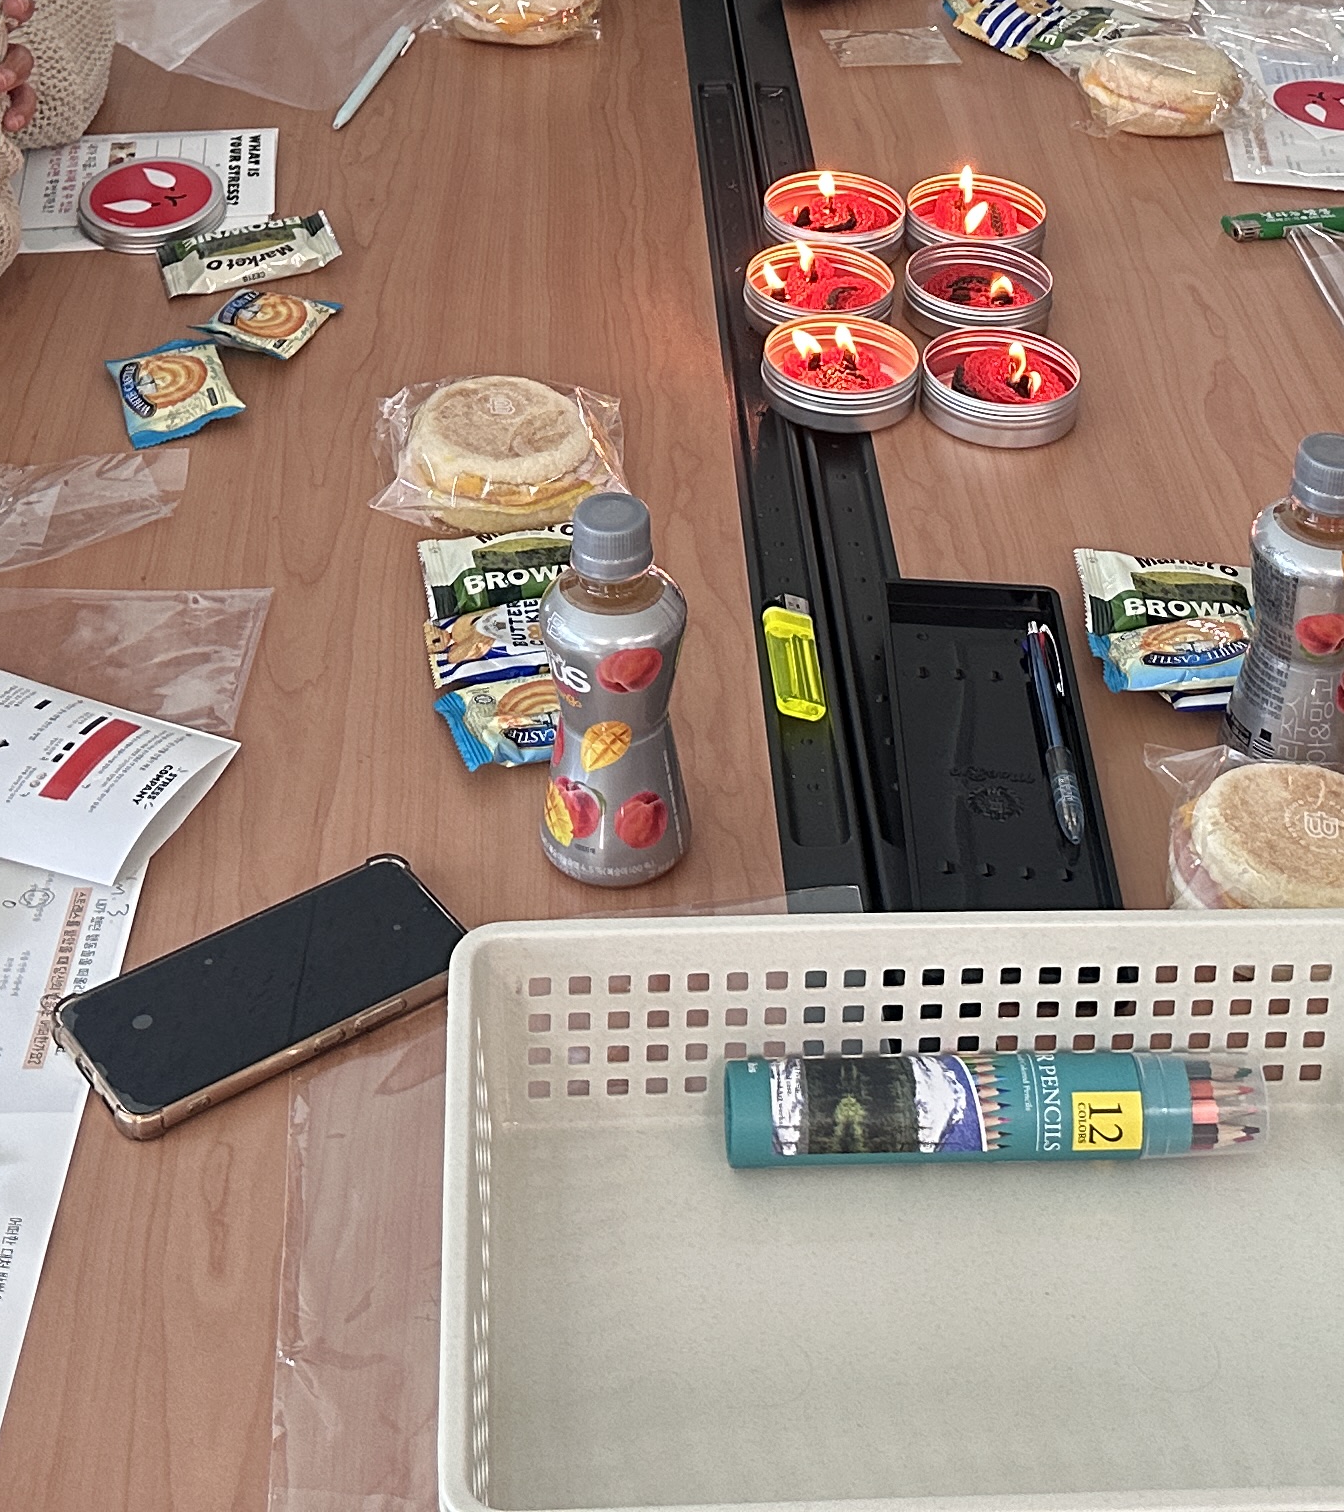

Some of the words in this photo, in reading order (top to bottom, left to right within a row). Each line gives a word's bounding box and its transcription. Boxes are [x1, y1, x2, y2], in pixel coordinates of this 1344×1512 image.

[228, 135, 242, 162] YOUR
[246, 134, 261, 165] WHAT
[225, 164, 240, 206] STRESS?
[246, 167, 259, 177] IS
[205, 259, 223, 271] O
[226, 244, 295, 270] Market
[463, 564, 570, 596] BROW
[507, 599, 528, 647] BUTTER
[1147, 654, 1201, 665] CASTLE
[1277, 695, 1307, 760] 리주스
[1308, 675, 1335, 764] 아&망고
[128, 763, 175, 805] COMPANY
[145, 772, 179, 801] STRESS
[64, 891, 89, 926] 스트레스를
[47, 966, 67, 990] 당신의
[1041, 1065, 1062, 1152] PENCILS
[1076, 1102, 1088, 1144] COLORS
[1086, 1102, 1124, 1146] 12
[1, 1217, 24, 1245] 어떠한
